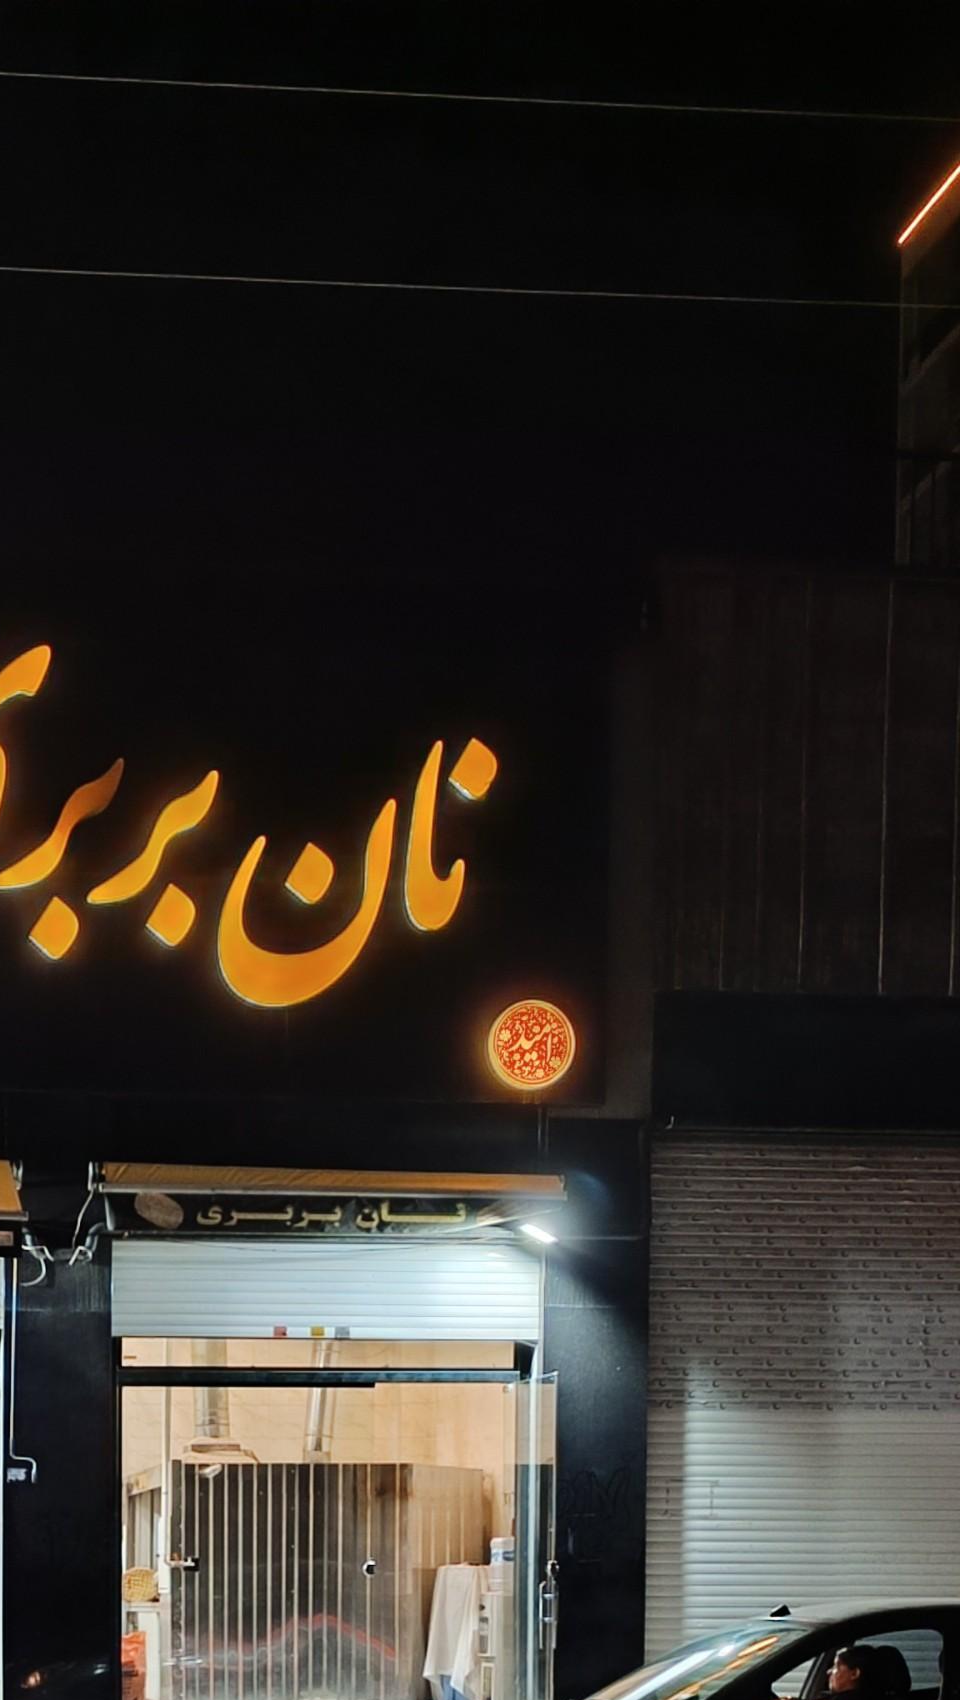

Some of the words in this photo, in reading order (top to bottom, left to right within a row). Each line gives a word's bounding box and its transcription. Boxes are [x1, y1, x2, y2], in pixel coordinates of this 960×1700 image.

[217, 737, 498, 1007] نان
[196, 1203, 343, 1228] بربری
[355, 1200, 467, 1229] نان
